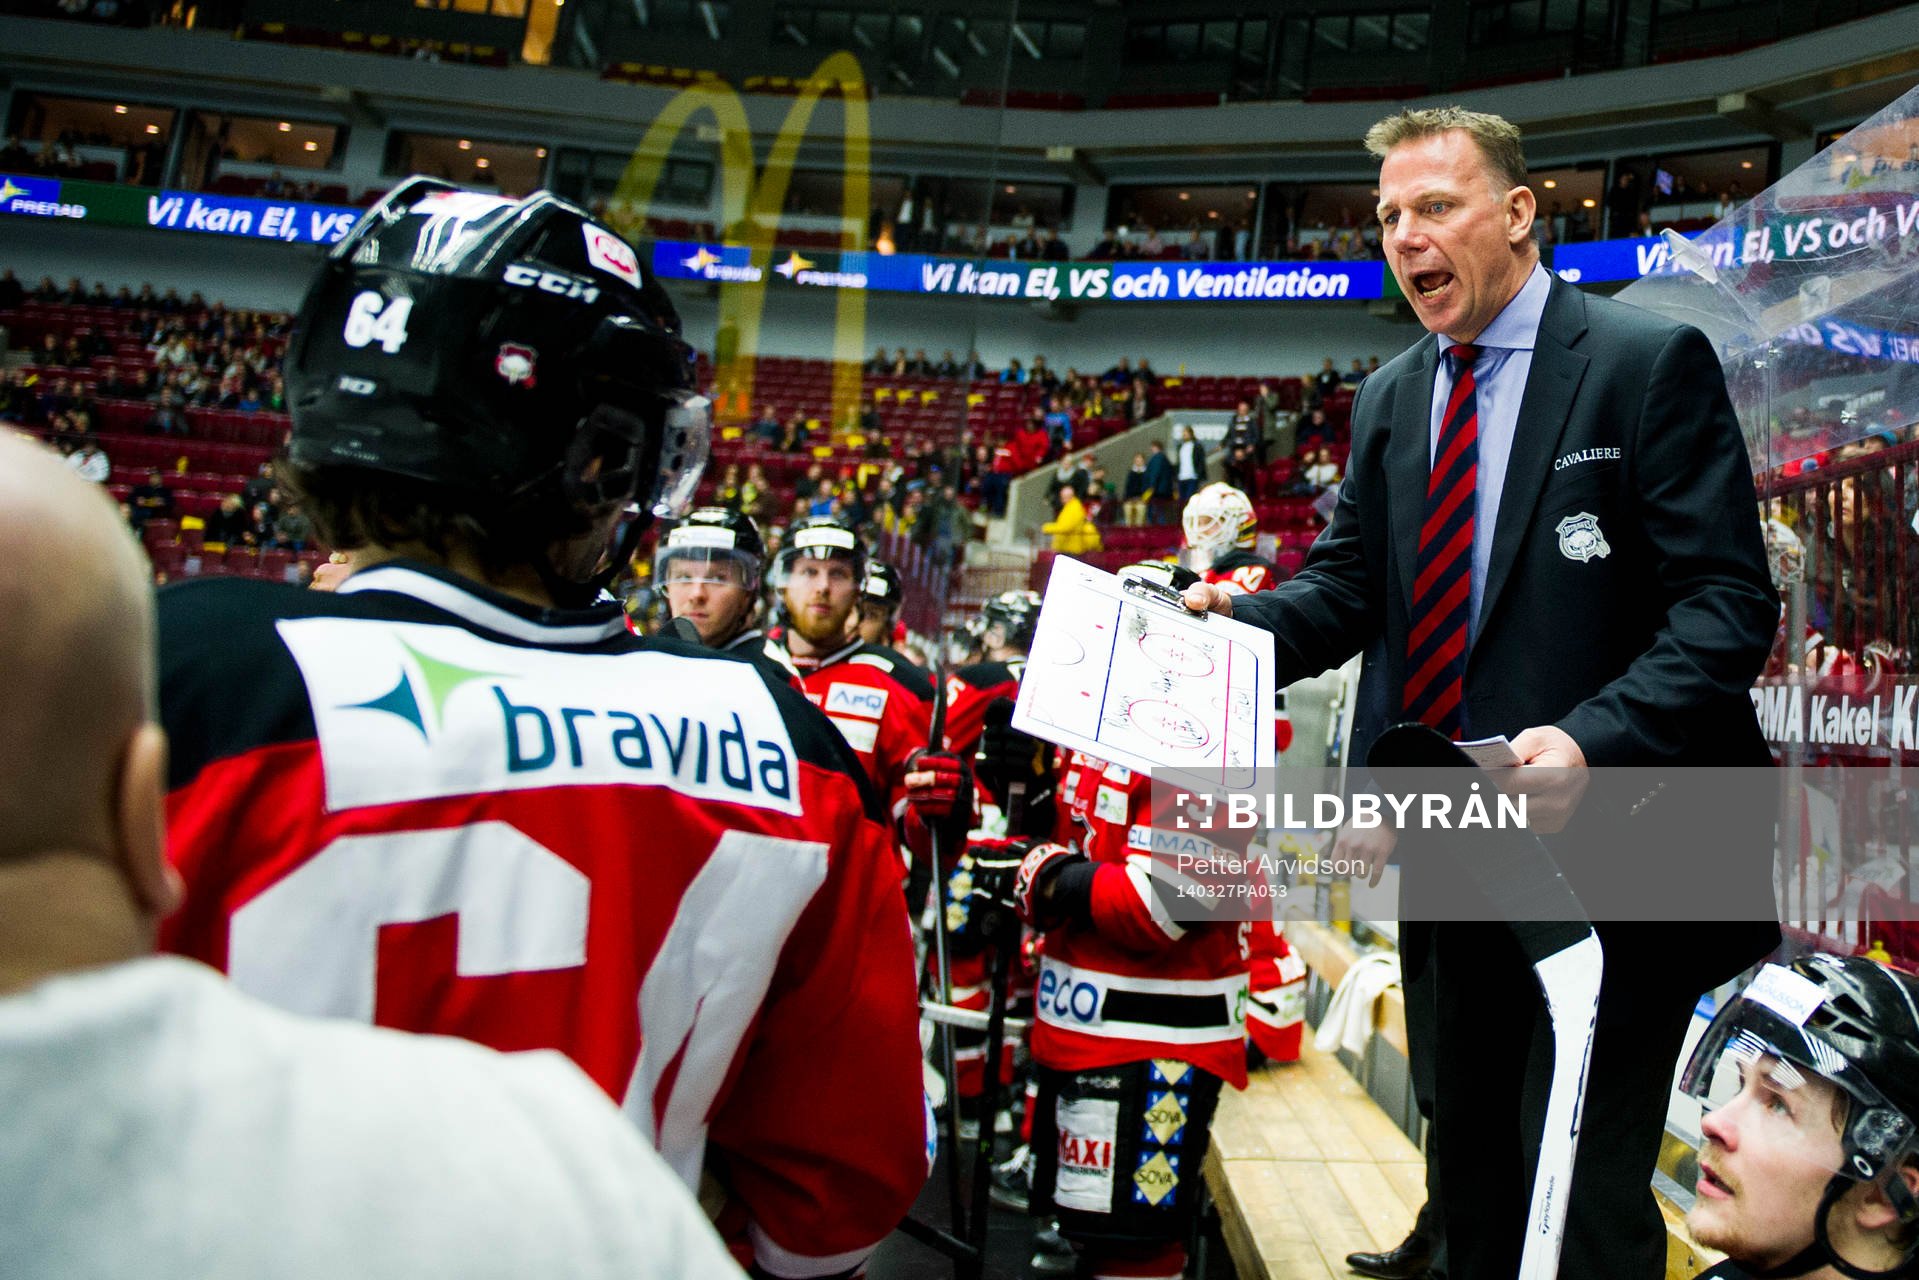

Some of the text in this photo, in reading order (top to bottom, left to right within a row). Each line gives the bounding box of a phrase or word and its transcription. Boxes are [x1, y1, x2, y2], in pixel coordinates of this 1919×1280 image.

[148, 196, 357, 242] Vi kan El, VS
[1742, 227, 1774, 264] El,
[1784, 217, 1823, 256] VS
[1828, 206, 1886, 249] och
[503, 264, 600, 304] CCM
[922, 263, 1349, 300] Vi kan El, VS och Ventilation
[343, 291, 413, 353] 64
[1554, 447, 1622, 471] CAVALIERE
[1809, 695, 1880, 746] Kakel
[490, 685, 792, 800] bravida
[1149, 1110, 1182, 1124] SOVA
[1136, 1170, 1174, 1186] SOVA
